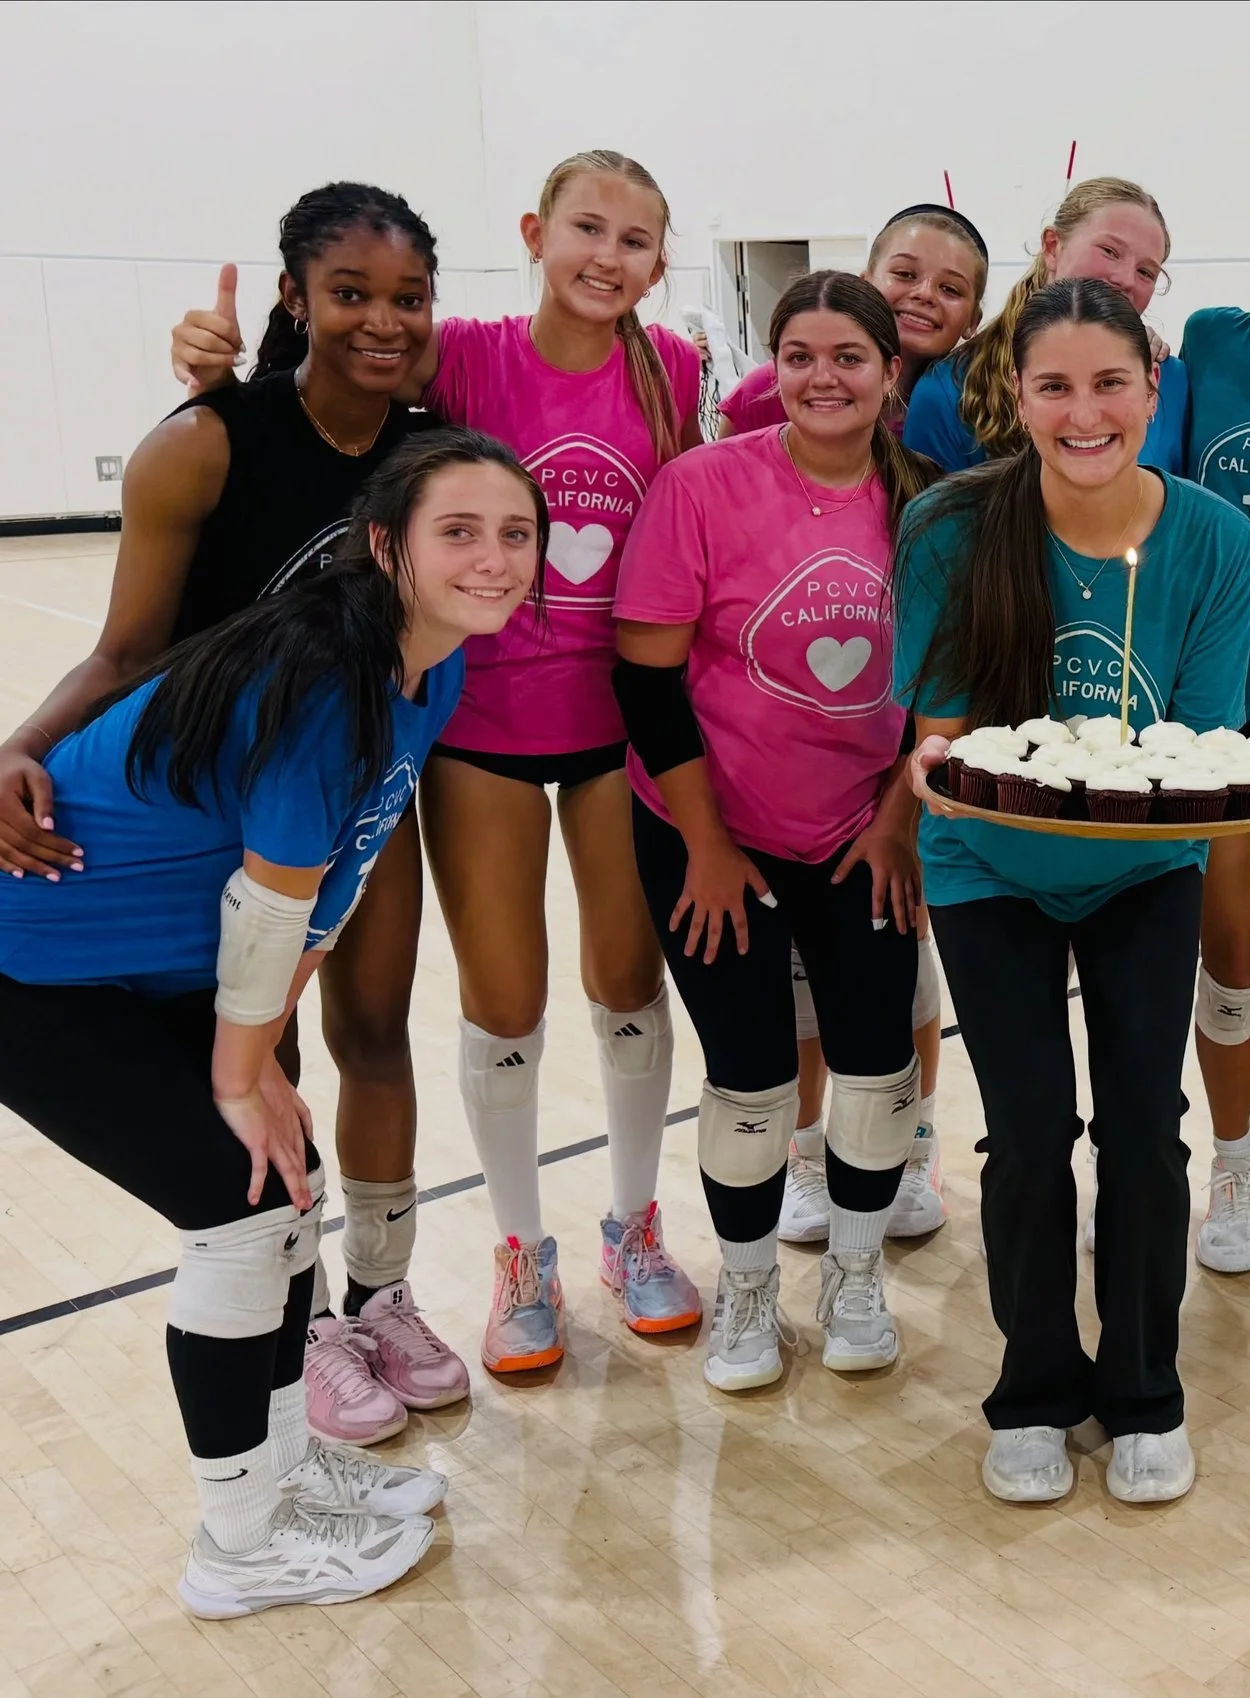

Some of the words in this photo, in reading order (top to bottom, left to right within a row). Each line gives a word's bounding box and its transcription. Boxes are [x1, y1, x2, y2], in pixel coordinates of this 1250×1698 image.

[541, 468, 619, 487] PCVC
[543, 490, 633, 517] LIFORNIA
[807, 581, 877, 597] PCVC
[1056, 680, 1138, 711] IFORNA
[385, 785, 407, 811] CVC
